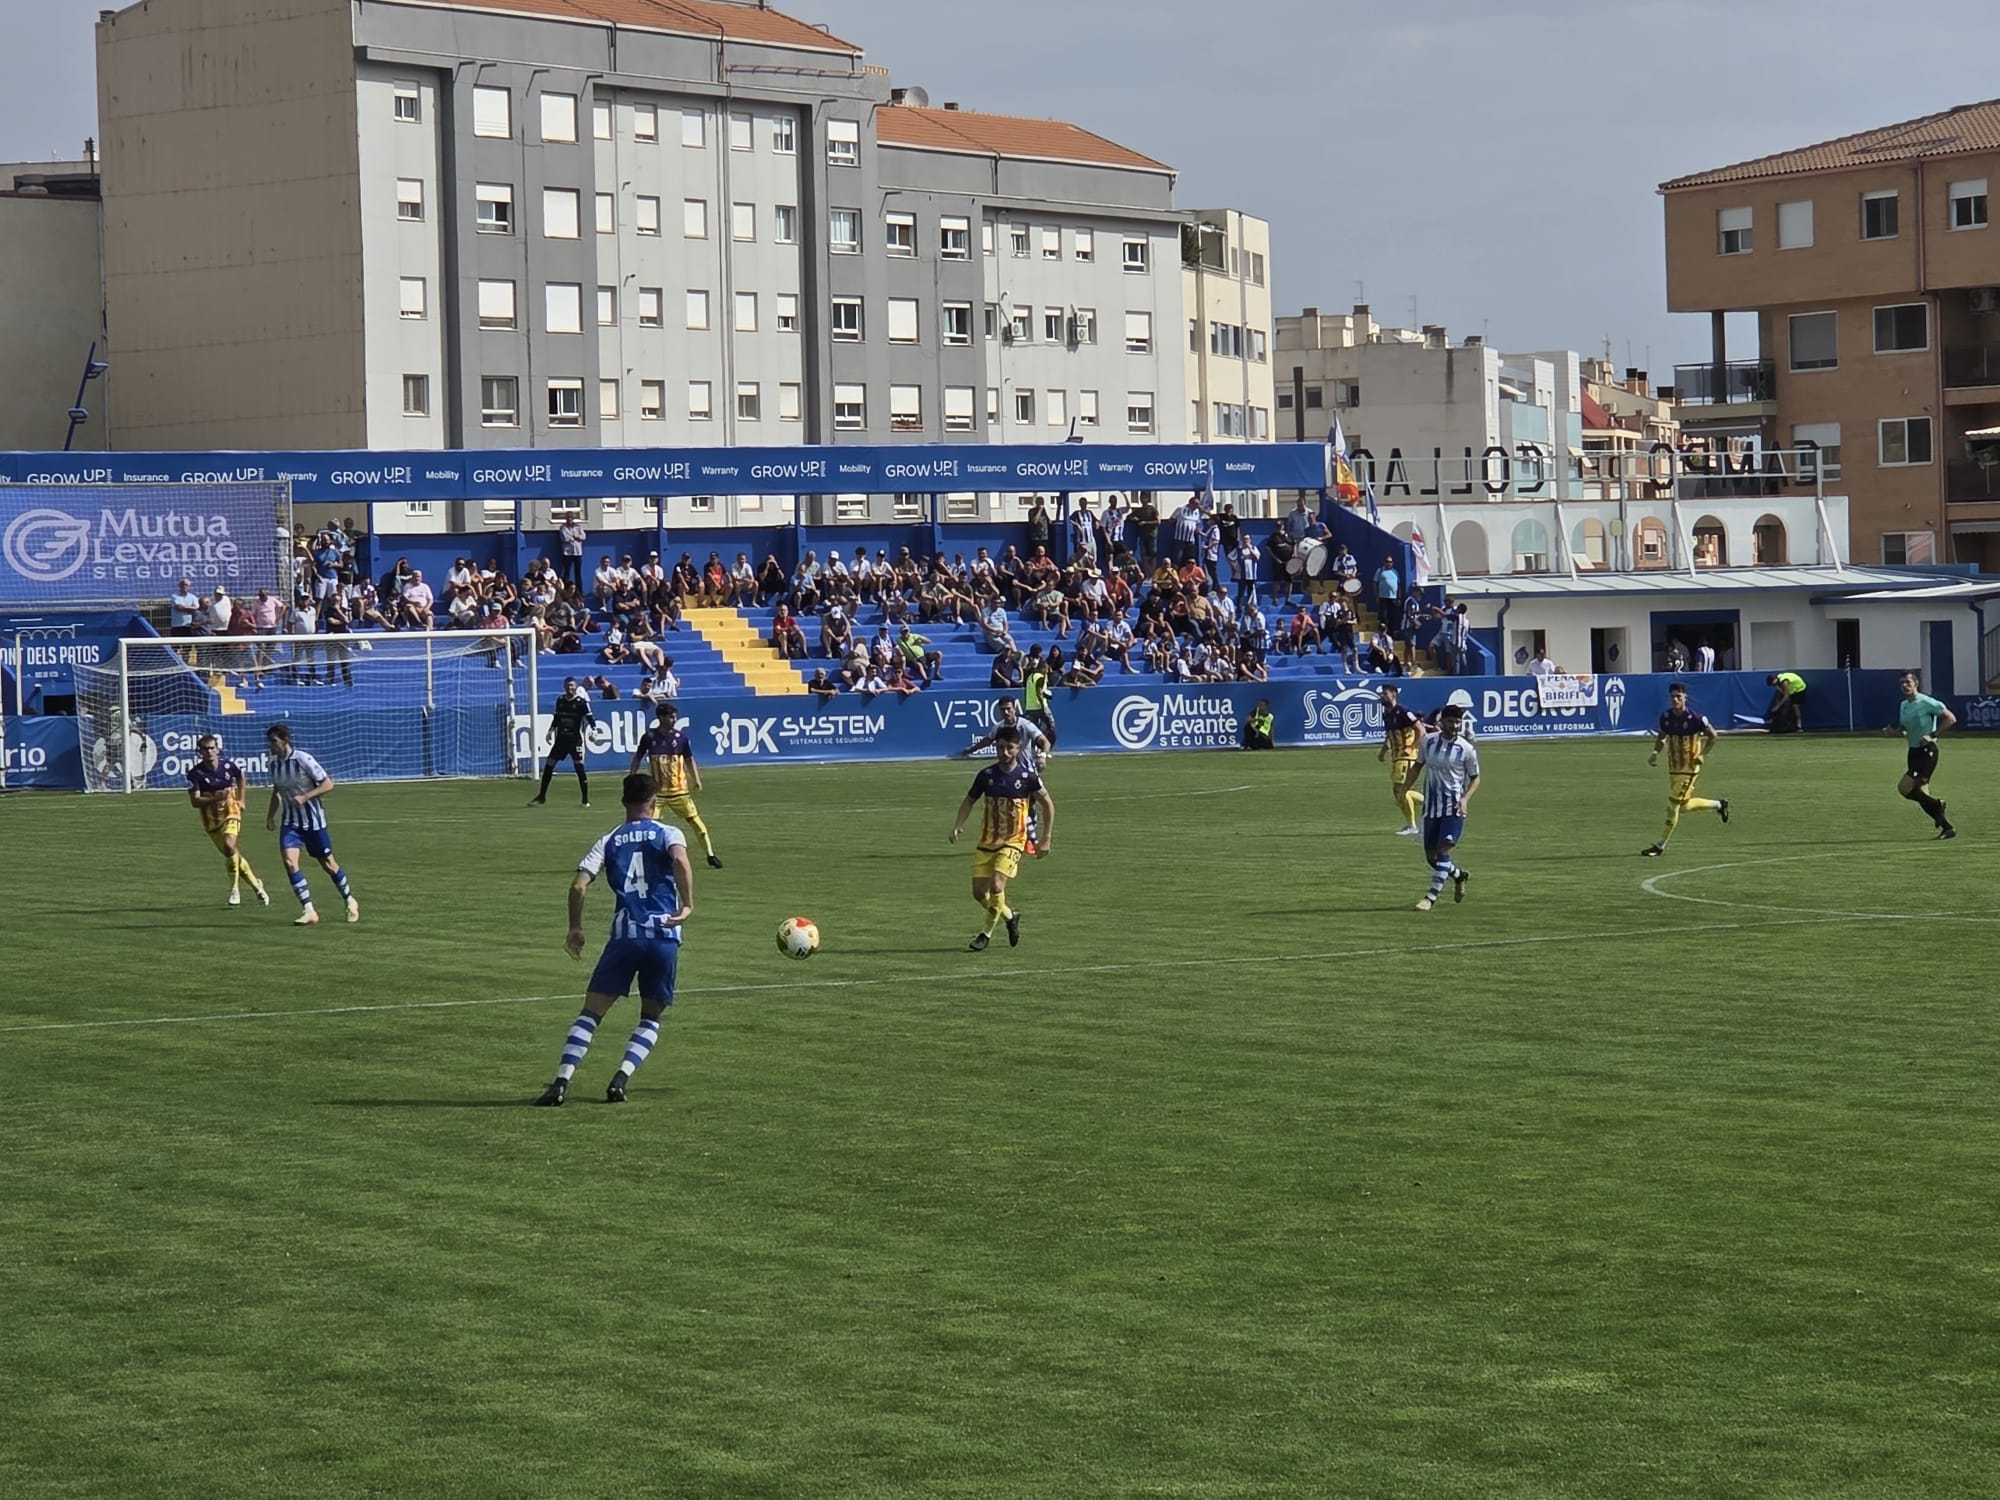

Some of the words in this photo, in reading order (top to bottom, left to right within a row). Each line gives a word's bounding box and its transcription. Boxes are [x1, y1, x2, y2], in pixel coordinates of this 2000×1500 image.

[560, 468, 604, 478] Insurance
[613, 467, 661, 480] GROW
[701, 465, 739, 477] Warranty
[750, 465, 798, 478] GROW
[839, 464, 872, 474] Mobility
[885, 464, 932, 477] GROW
[967, 463, 1007, 473] Insurance
[1016, 463, 1062, 476] GROW
[1098, 462, 1133, 473] Warranty
[1144, 462, 1188, 475] GROW
[1225, 462, 1256, 472] Mobility
[27, 473, 80, 484] GROW
[123, 472, 170, 482] Insurance
[181, 472, 233, 483] GROW
[277, 471, 318, 482] Warranty
[330, 470, 381, 485] GROW
[425, 470, 460, 481] Mobility
[473, 469, 522, 483] GROW
[99, 508, 231, 538] Mutua
[92, 536, 239, 564] Levante
[92, 564, 240, 579] SEGUROS
[27, 646, 57, 665] DELS
[59, 645, 100, 665] PATOS
[1162, 693, 1234, 716] Mutua
[1159, 714, 1238, 736] Levante
[1482, 723, 1544, 733] CONSTRUCCIÓN
[1553, 722, 1595, 731] REFORMAS
[731, 717, 780, 754] DK
[778, 714, 885, 737] SYSTEM
[789, 737, 822, 745] SISTEMAS
[823, 737, 833, 745] DE
[835, 736, 875, 744] SEGURIDAD
[1159, 734, 1236, 747] SEGUROS
[623, 850, 649, 899] 4
